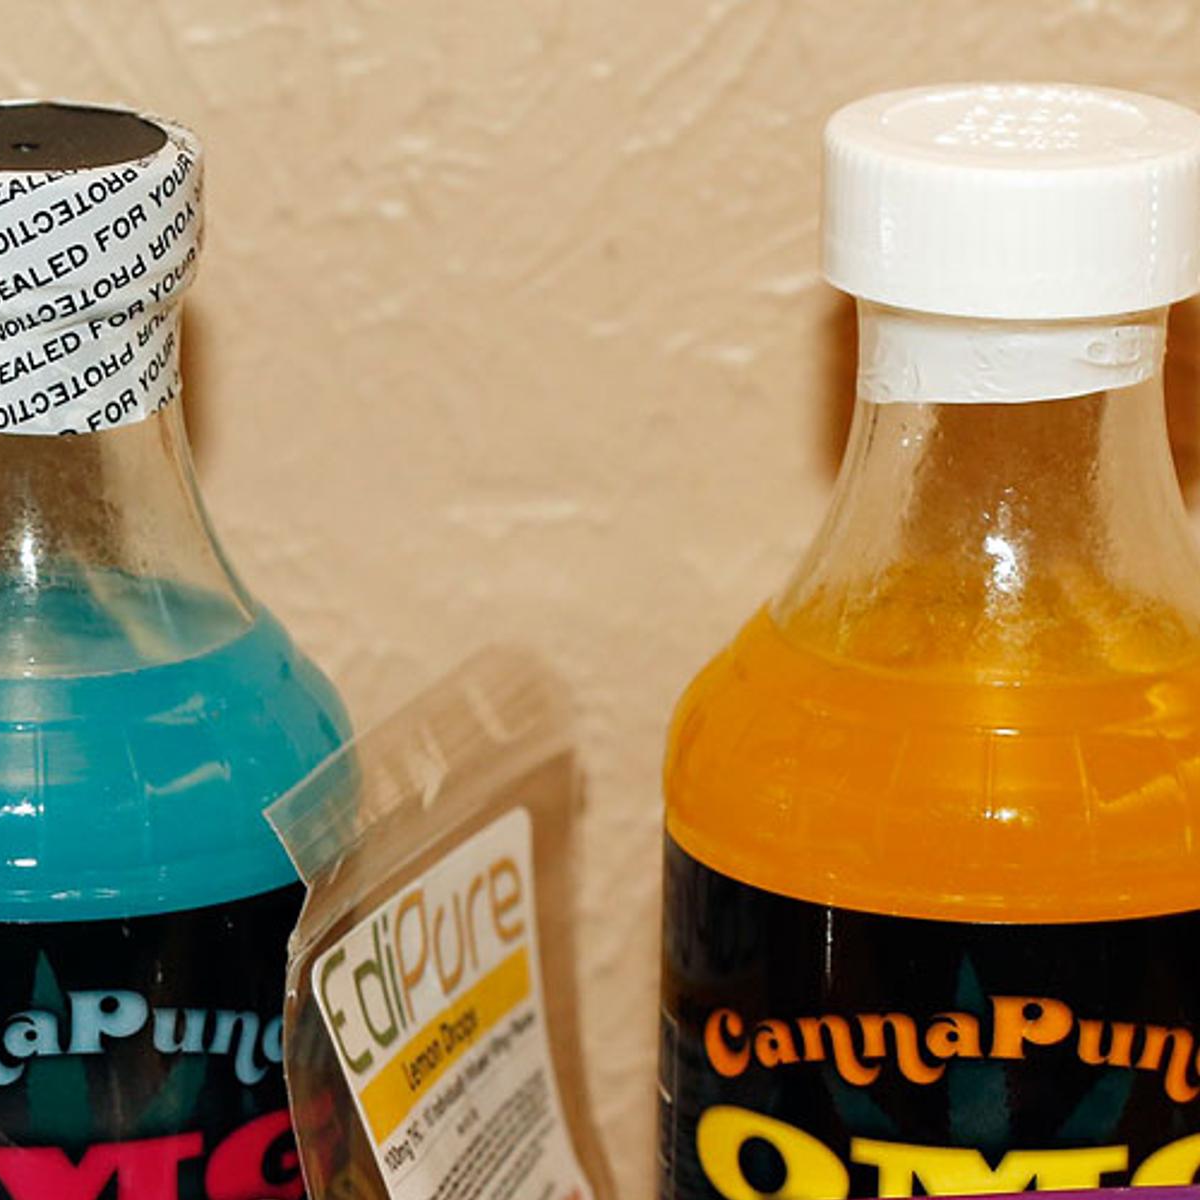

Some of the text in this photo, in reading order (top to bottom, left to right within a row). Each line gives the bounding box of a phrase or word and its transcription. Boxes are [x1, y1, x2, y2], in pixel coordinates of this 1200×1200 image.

[94, 204, 148, 252] FOR
[148, 153, 194, 208] YOUR
[88, 300, 145, 339] FOR
[86, 388, 138, 432] FOR
[138, 331, 176, 392] YOUR
[320, 856, 524, 1076] EdiPure
[704, 994, 1200, 1103] CannaPun
